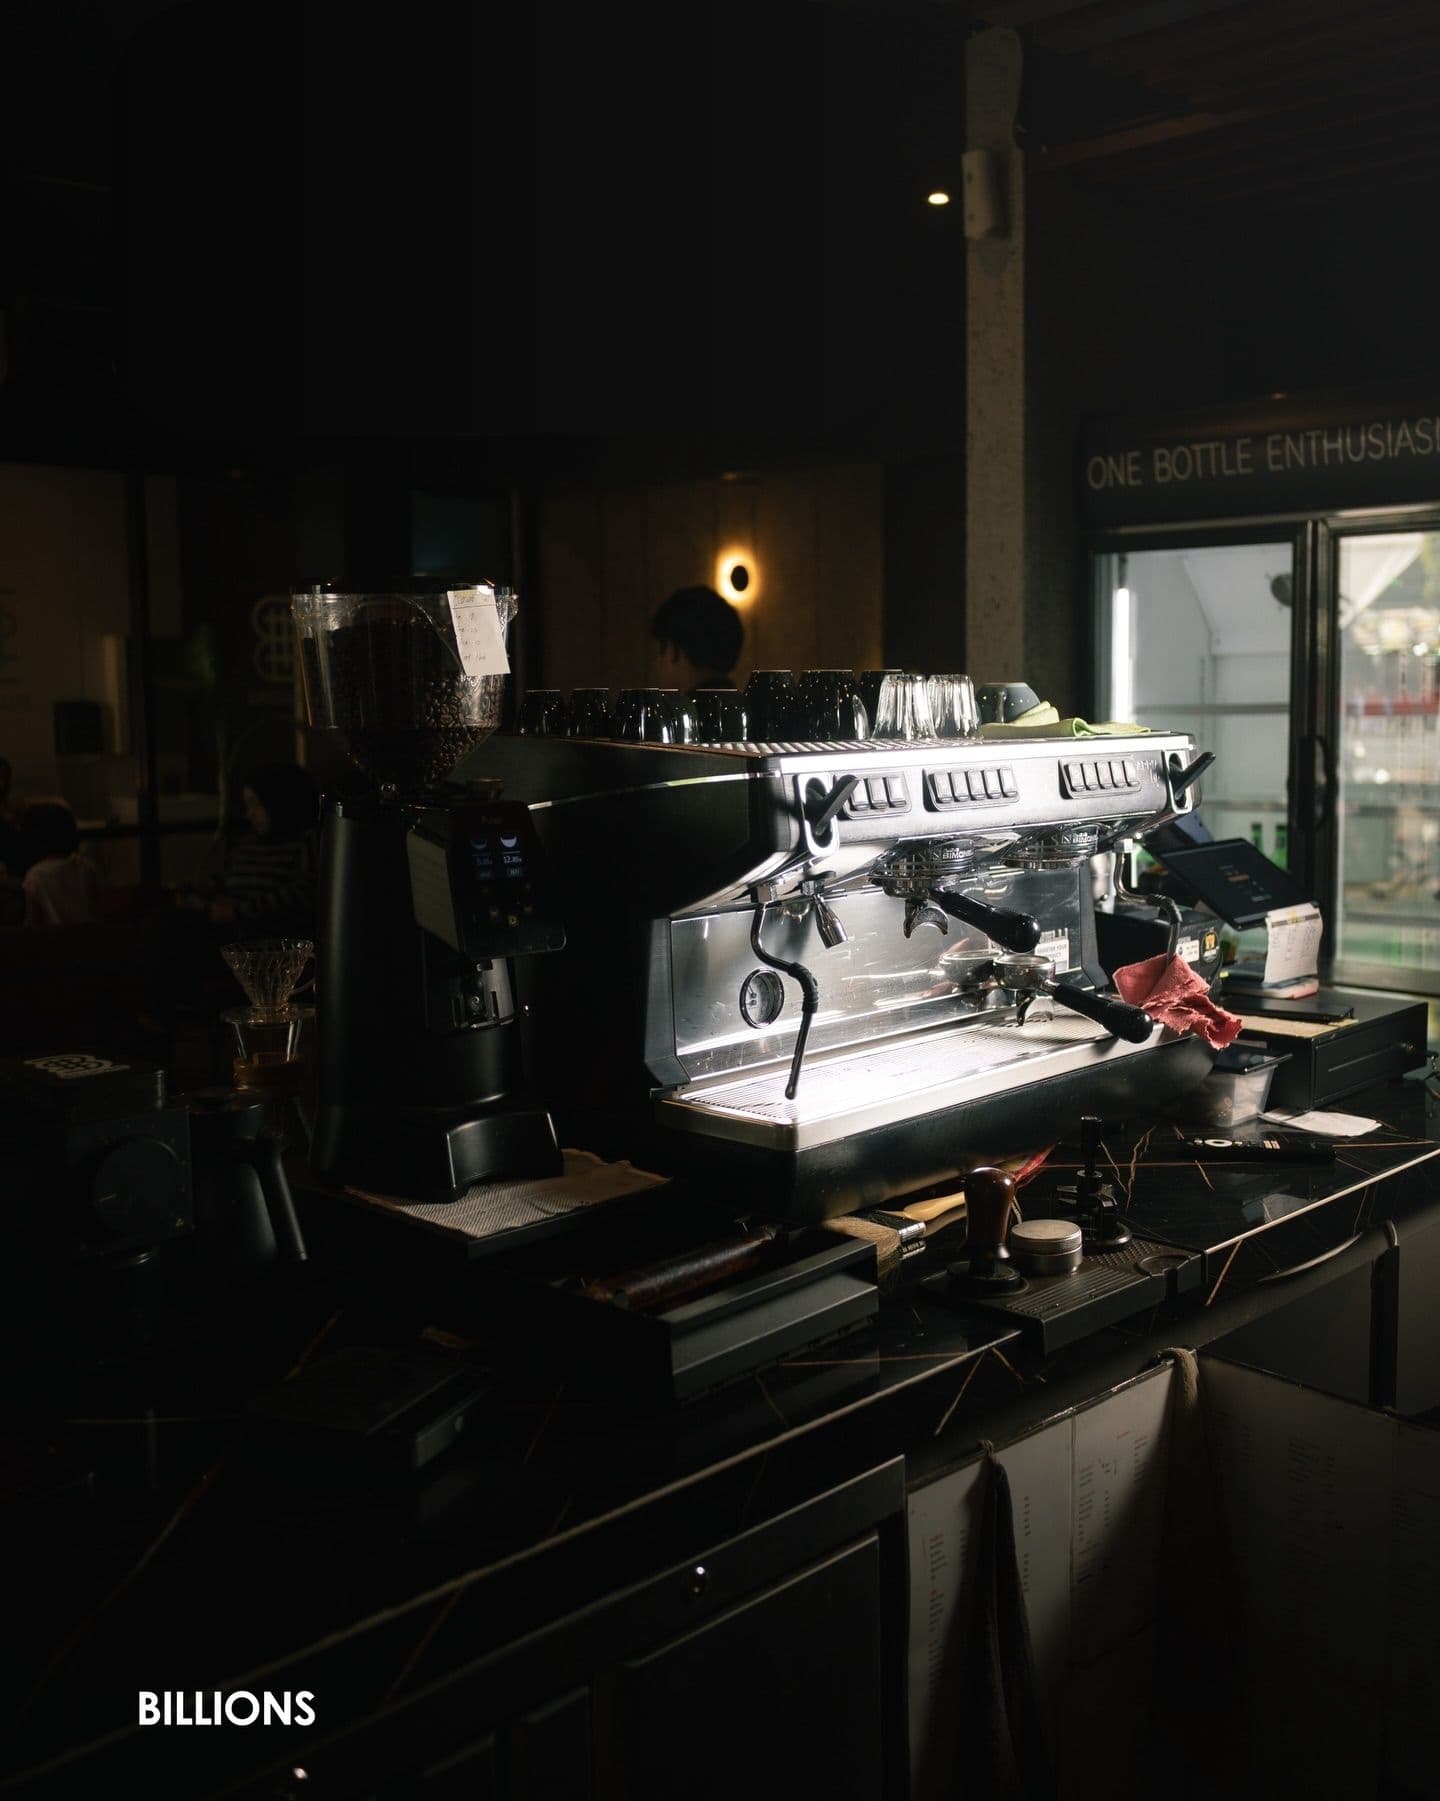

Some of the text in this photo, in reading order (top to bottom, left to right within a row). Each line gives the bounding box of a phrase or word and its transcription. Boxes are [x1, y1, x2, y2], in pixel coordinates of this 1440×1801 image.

[1086, 417, 1440, 491] ONE BOTTLE ENTHUSIAS
